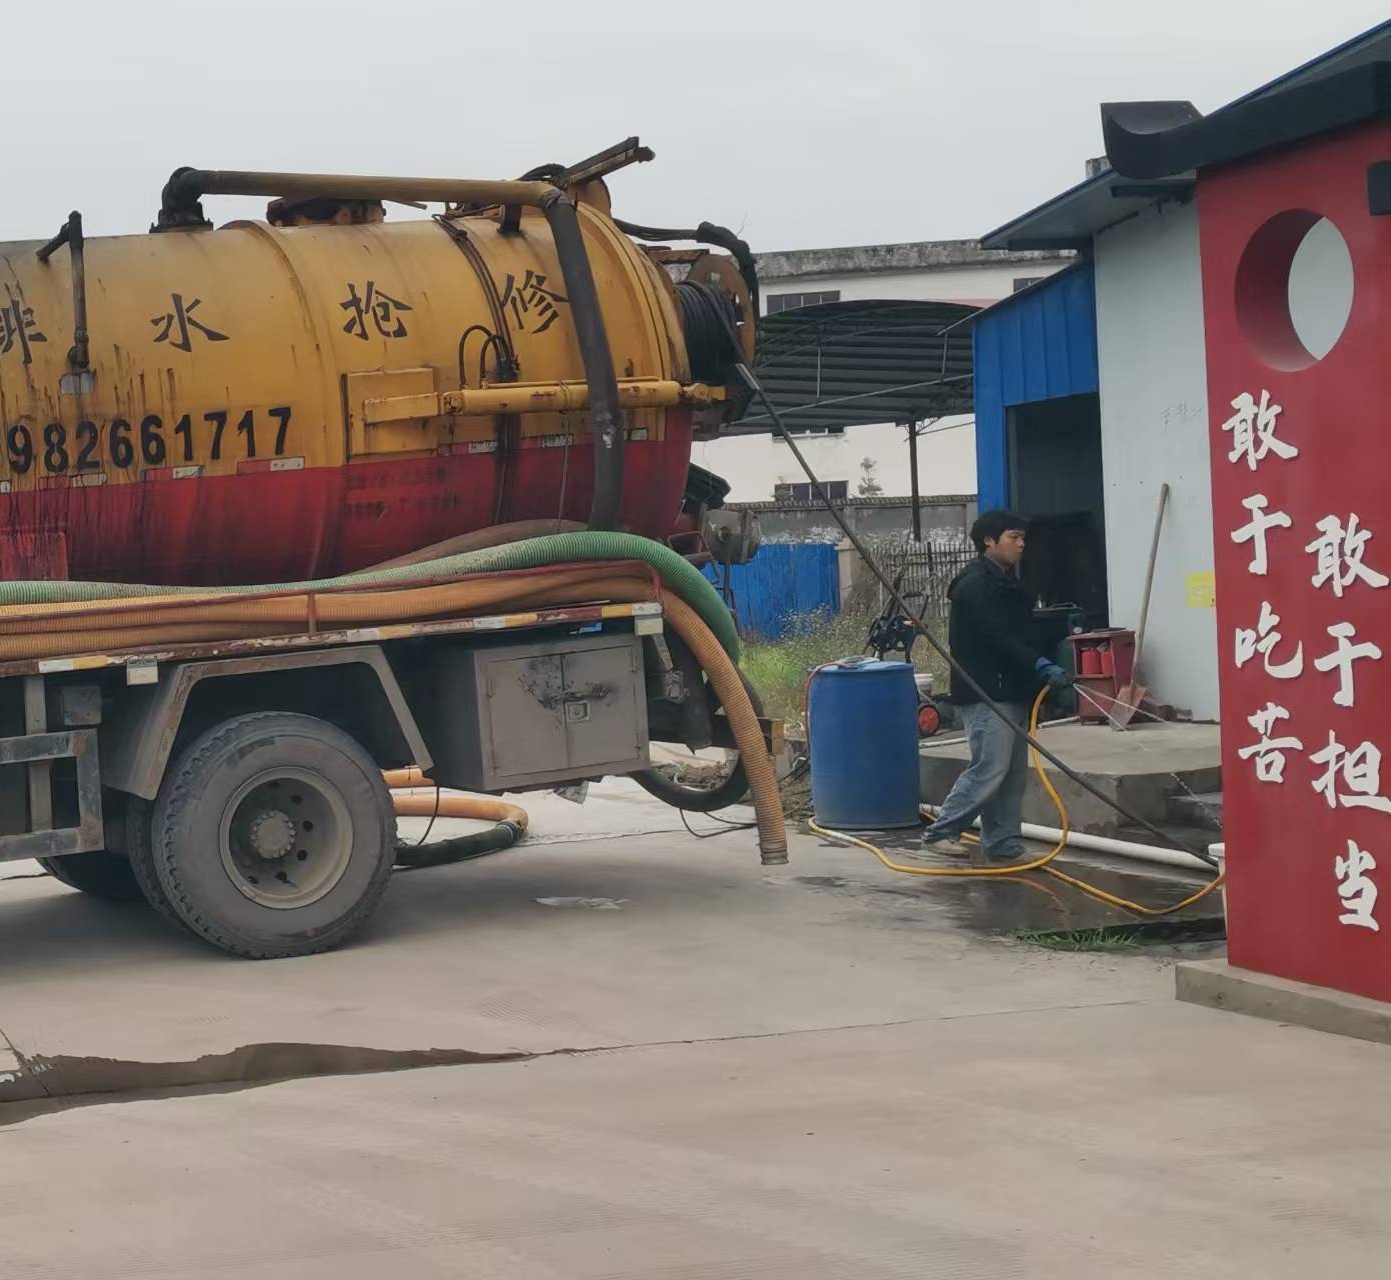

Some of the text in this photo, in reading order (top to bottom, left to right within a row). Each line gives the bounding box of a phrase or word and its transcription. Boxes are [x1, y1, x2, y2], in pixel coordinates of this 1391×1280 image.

[1221, 389, 1304, 784] 敢于吃苦
[1305, 512, 1391, 932] 敢于担当
